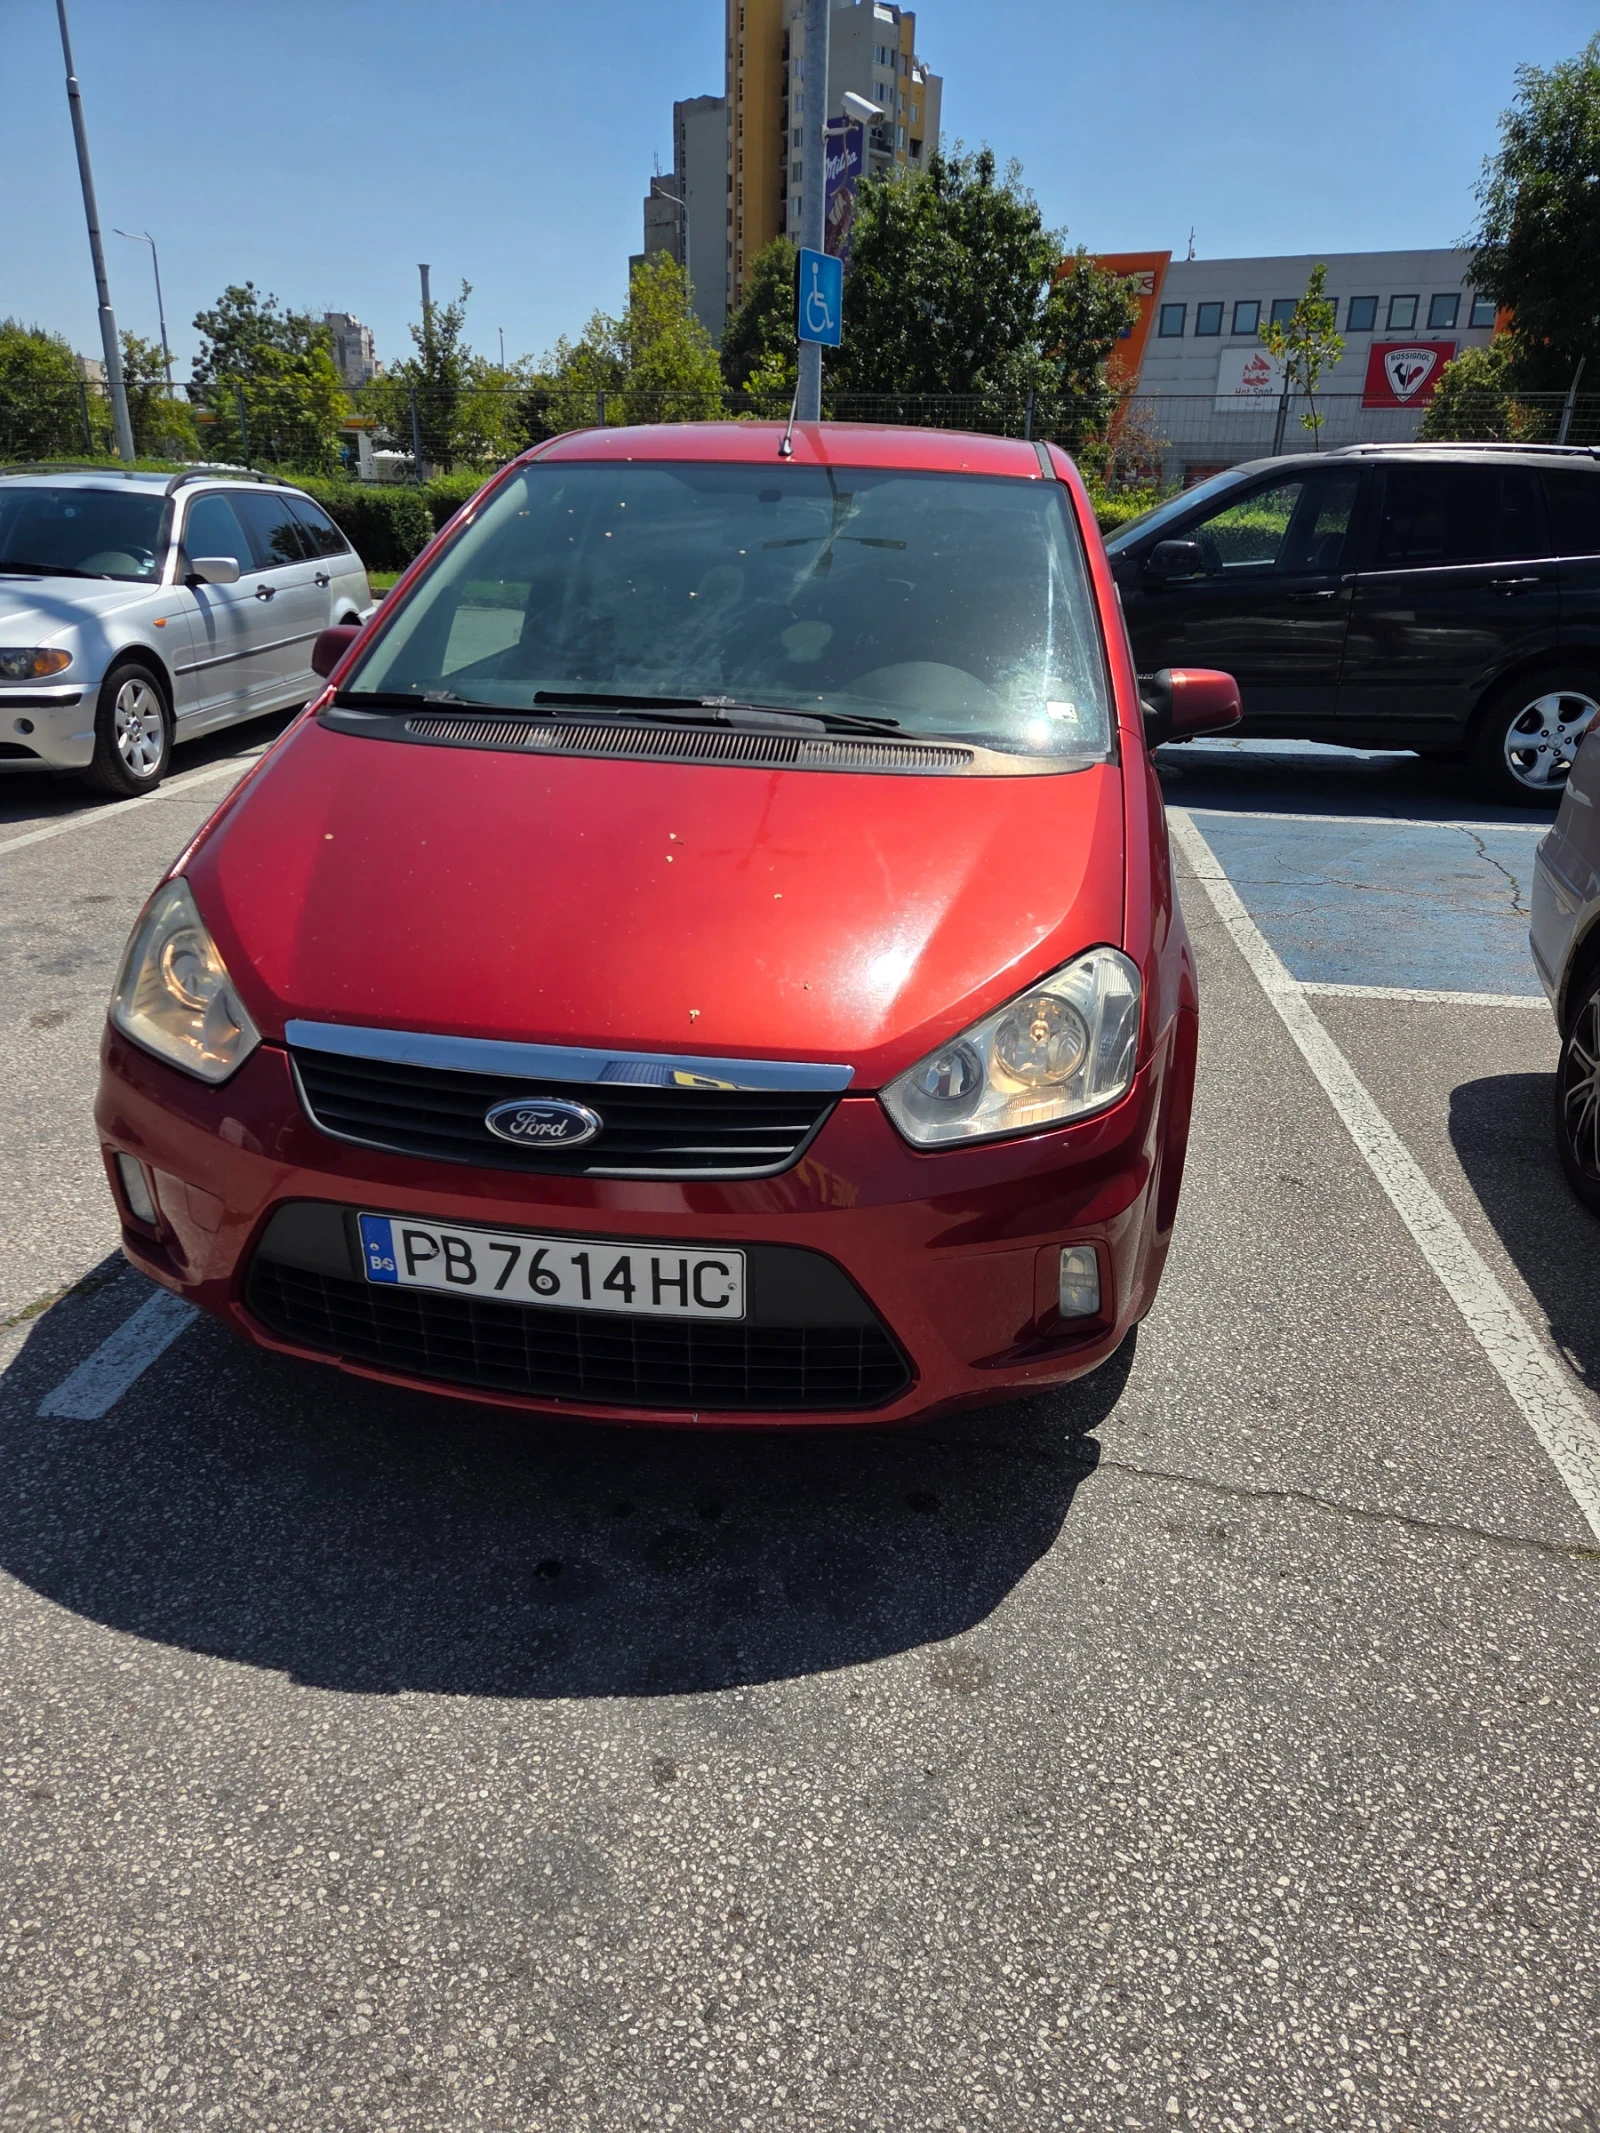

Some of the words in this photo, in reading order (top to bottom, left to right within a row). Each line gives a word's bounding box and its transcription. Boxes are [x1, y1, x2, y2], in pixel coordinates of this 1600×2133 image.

[1390, 352, 1430, 362] ROSSIGNOL
[509, 1110, 568, 1137] Ford
[370, 1255, 395, 1271] BG
